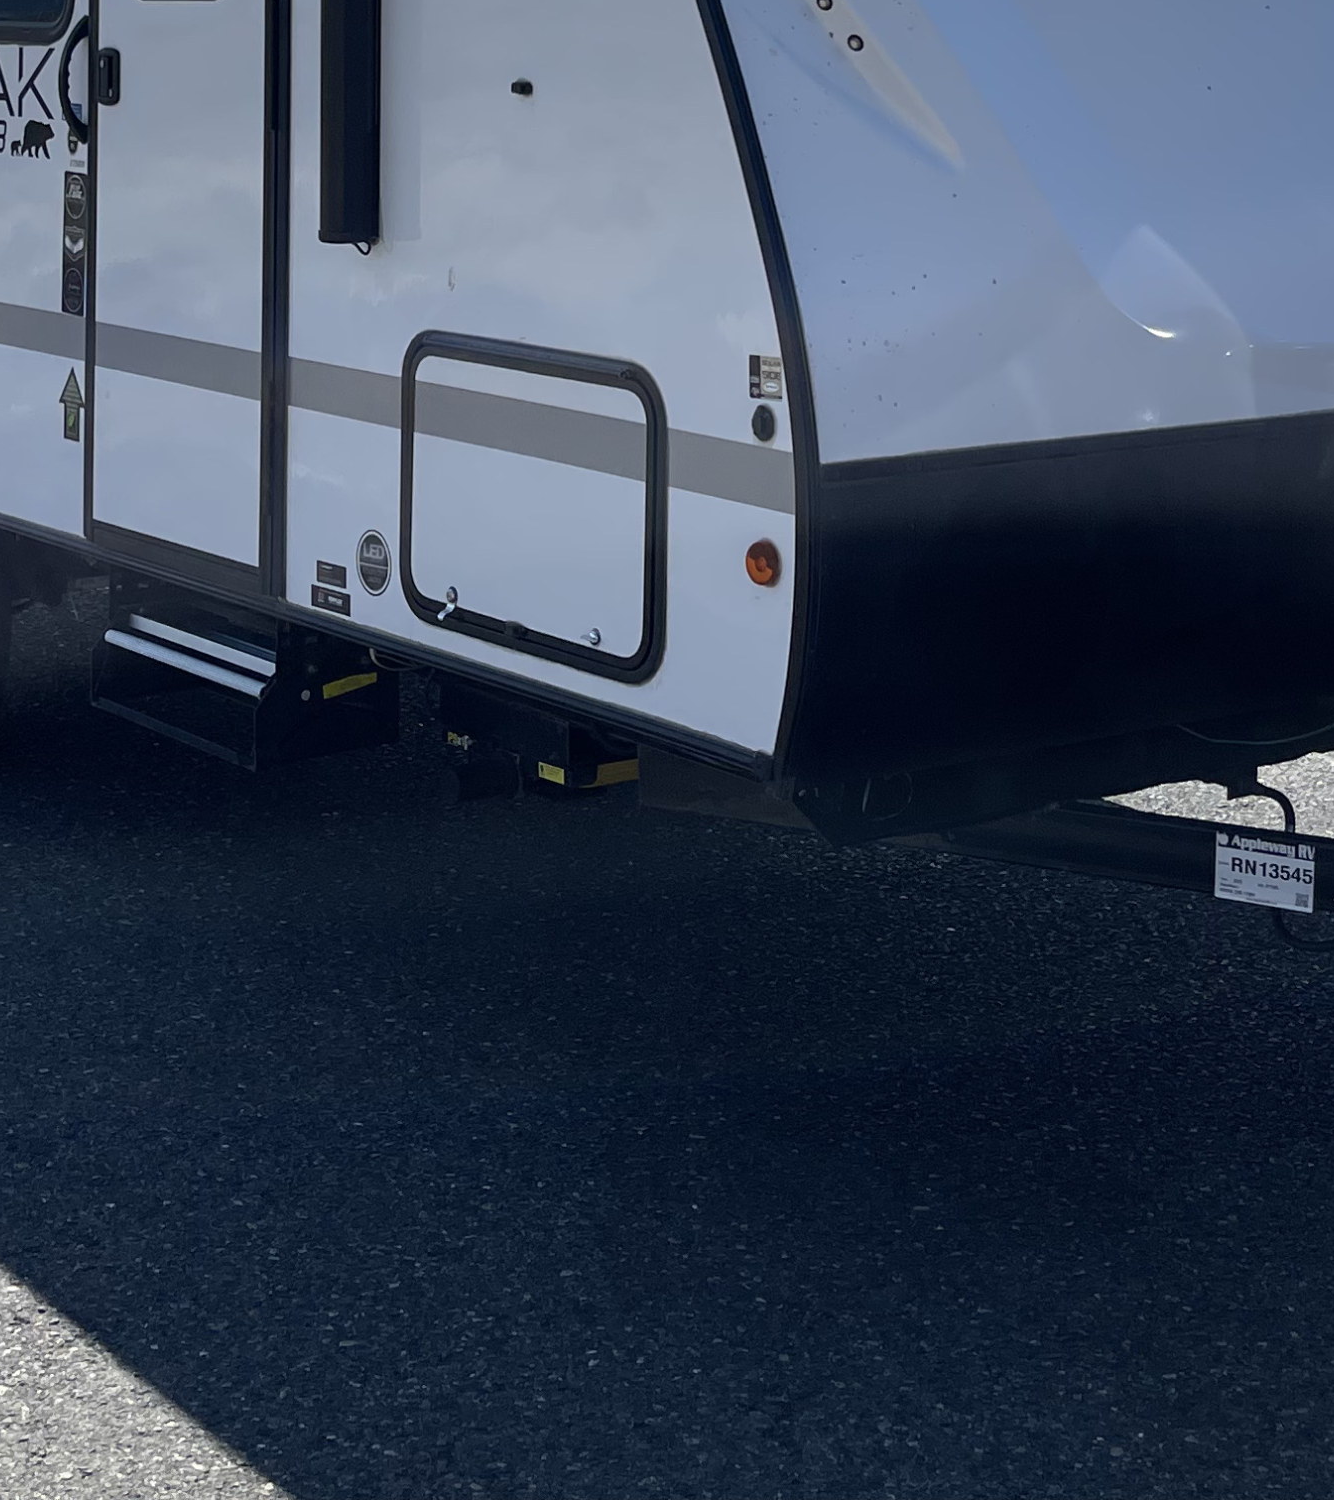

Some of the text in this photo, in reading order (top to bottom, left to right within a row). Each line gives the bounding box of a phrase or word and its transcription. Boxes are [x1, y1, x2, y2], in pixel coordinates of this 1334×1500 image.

[363, 542, 385, 560] LED
[1231, 835, 1316, 860] Appleway RV
[1231, 857, 1314, 885] RN13545
